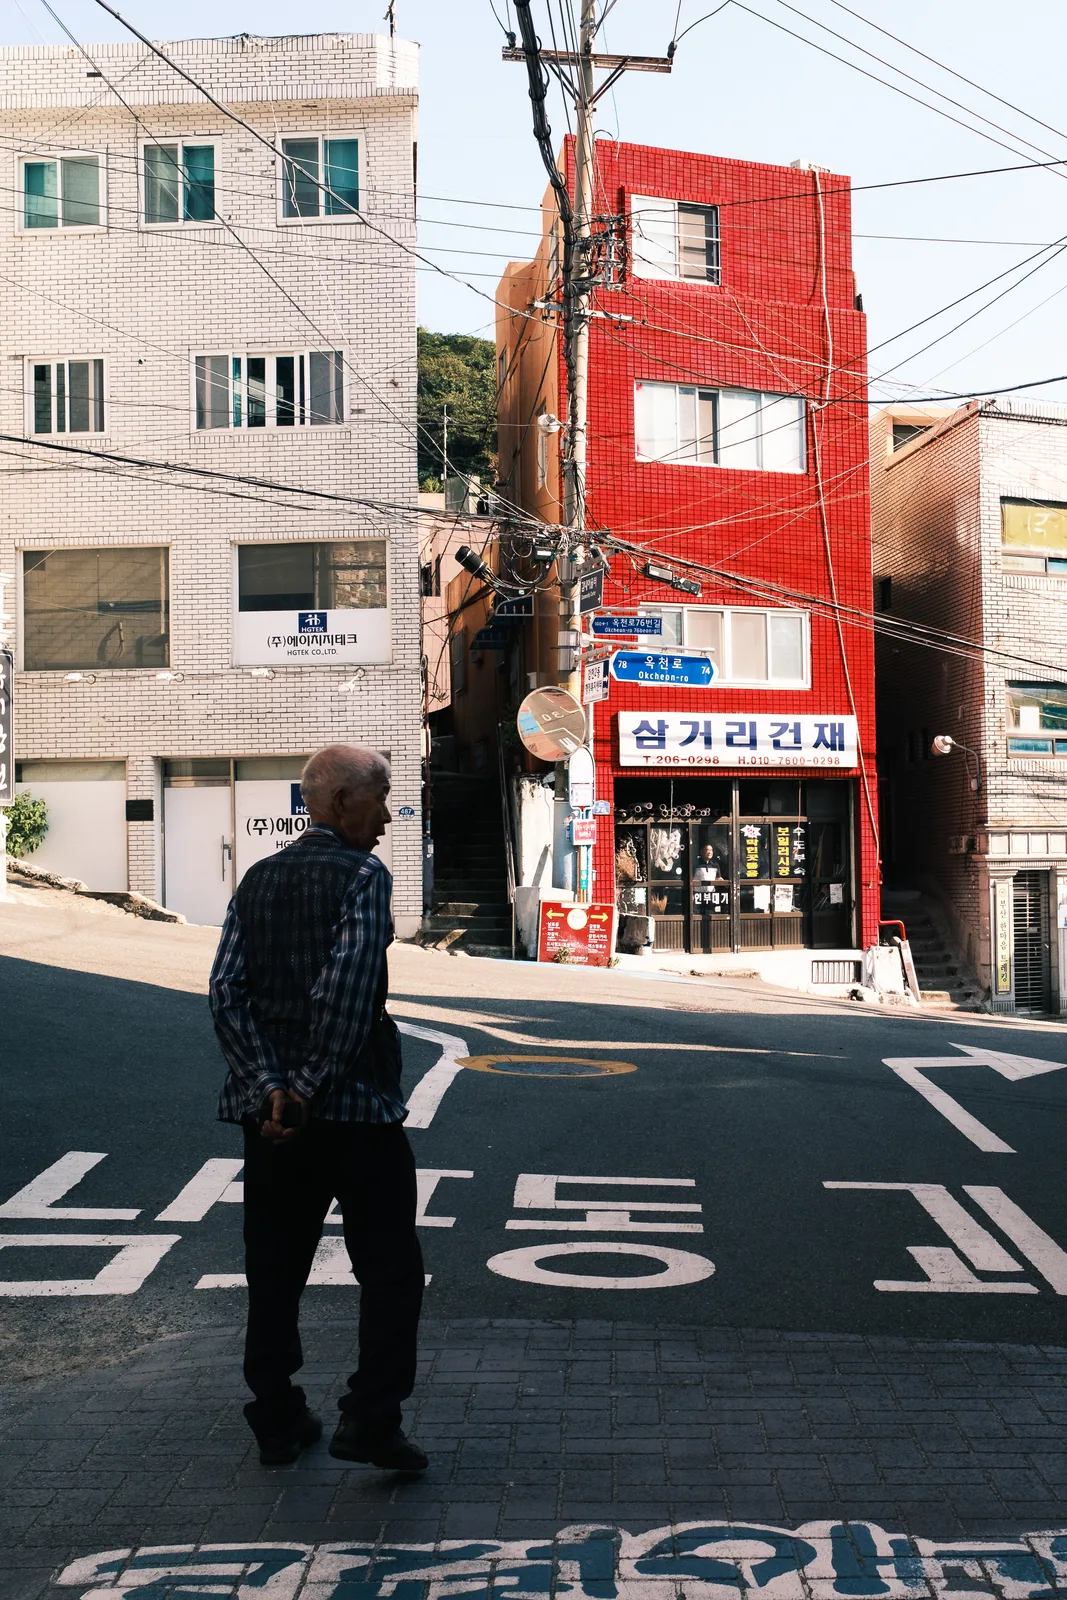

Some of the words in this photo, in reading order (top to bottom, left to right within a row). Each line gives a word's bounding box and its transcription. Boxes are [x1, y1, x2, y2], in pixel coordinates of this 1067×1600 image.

[612, 618, 661, 628] 옥천로76번길
[267, 634, 358, 648] (주)에이치지테크
[617, 659, 627, 669] 78
[701, 665, 711, 676] 74
[638, 671, 689, 683] Okcheon-ro
[631, 719, 845, 752] 삼거리건재
[643, 755, 720, 765] T.206-0298
[738, 755, 840, 766] H.010-7600-0298
[777, 826, 790, 876] 보일러시공
[694, 892, 729, 905] 인부대기
